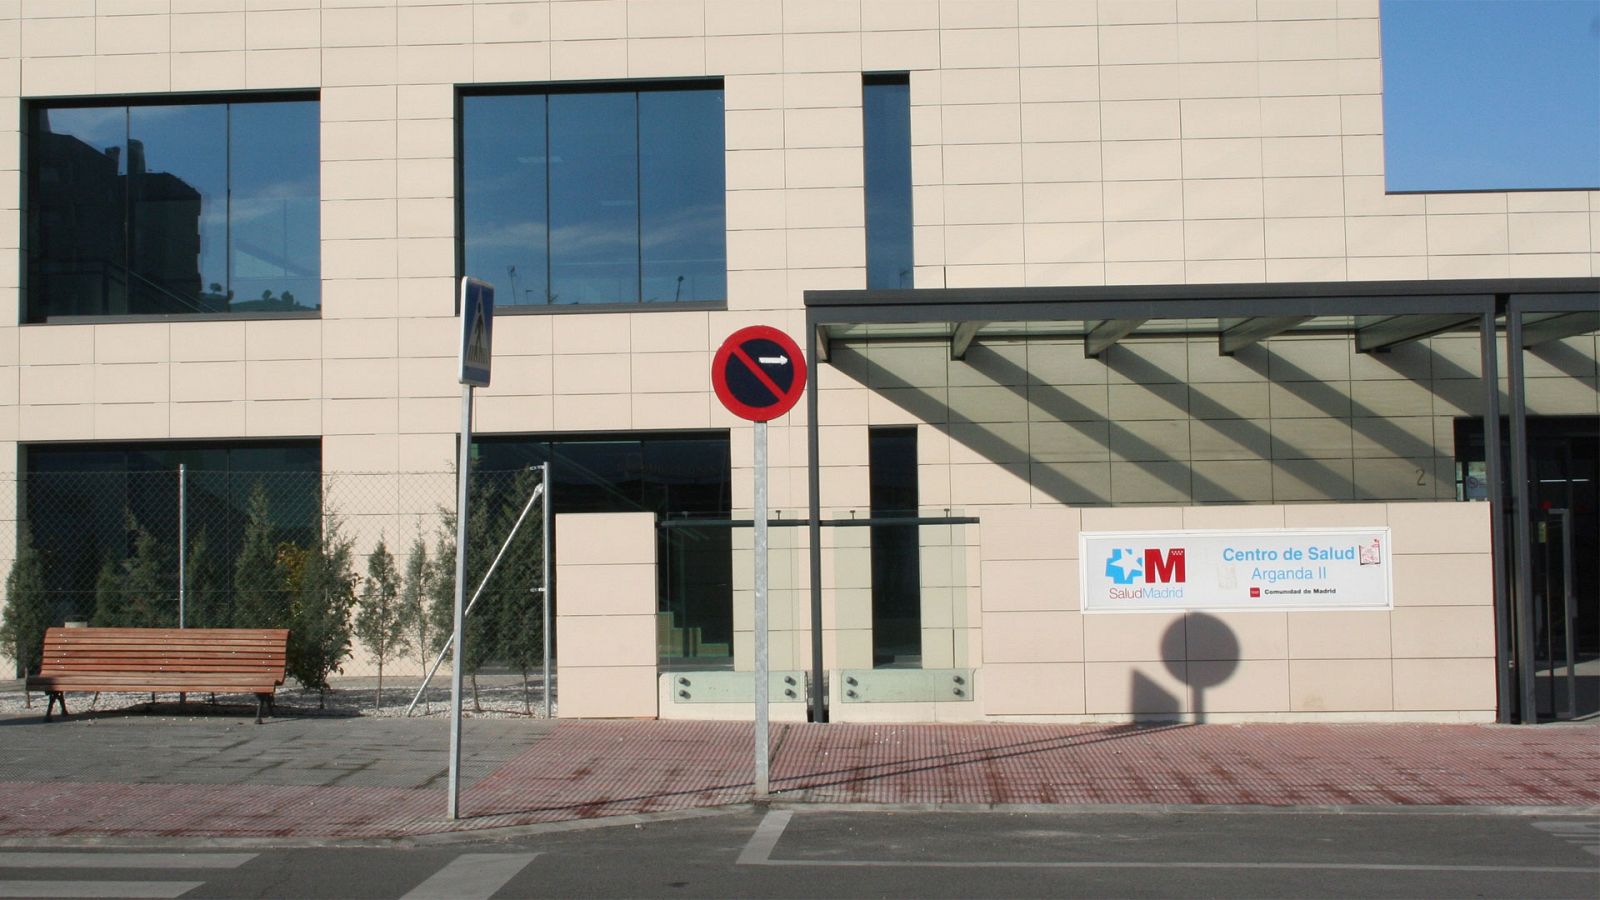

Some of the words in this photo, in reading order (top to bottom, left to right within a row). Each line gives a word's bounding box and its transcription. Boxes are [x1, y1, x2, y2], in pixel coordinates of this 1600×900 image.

[1222, 547, 1278, 561] Centro
[1283, 547, 1303, 560] de
[1308, 546, 1355, 560] Salud
[1251, 566, 1313, 583] Arganda
